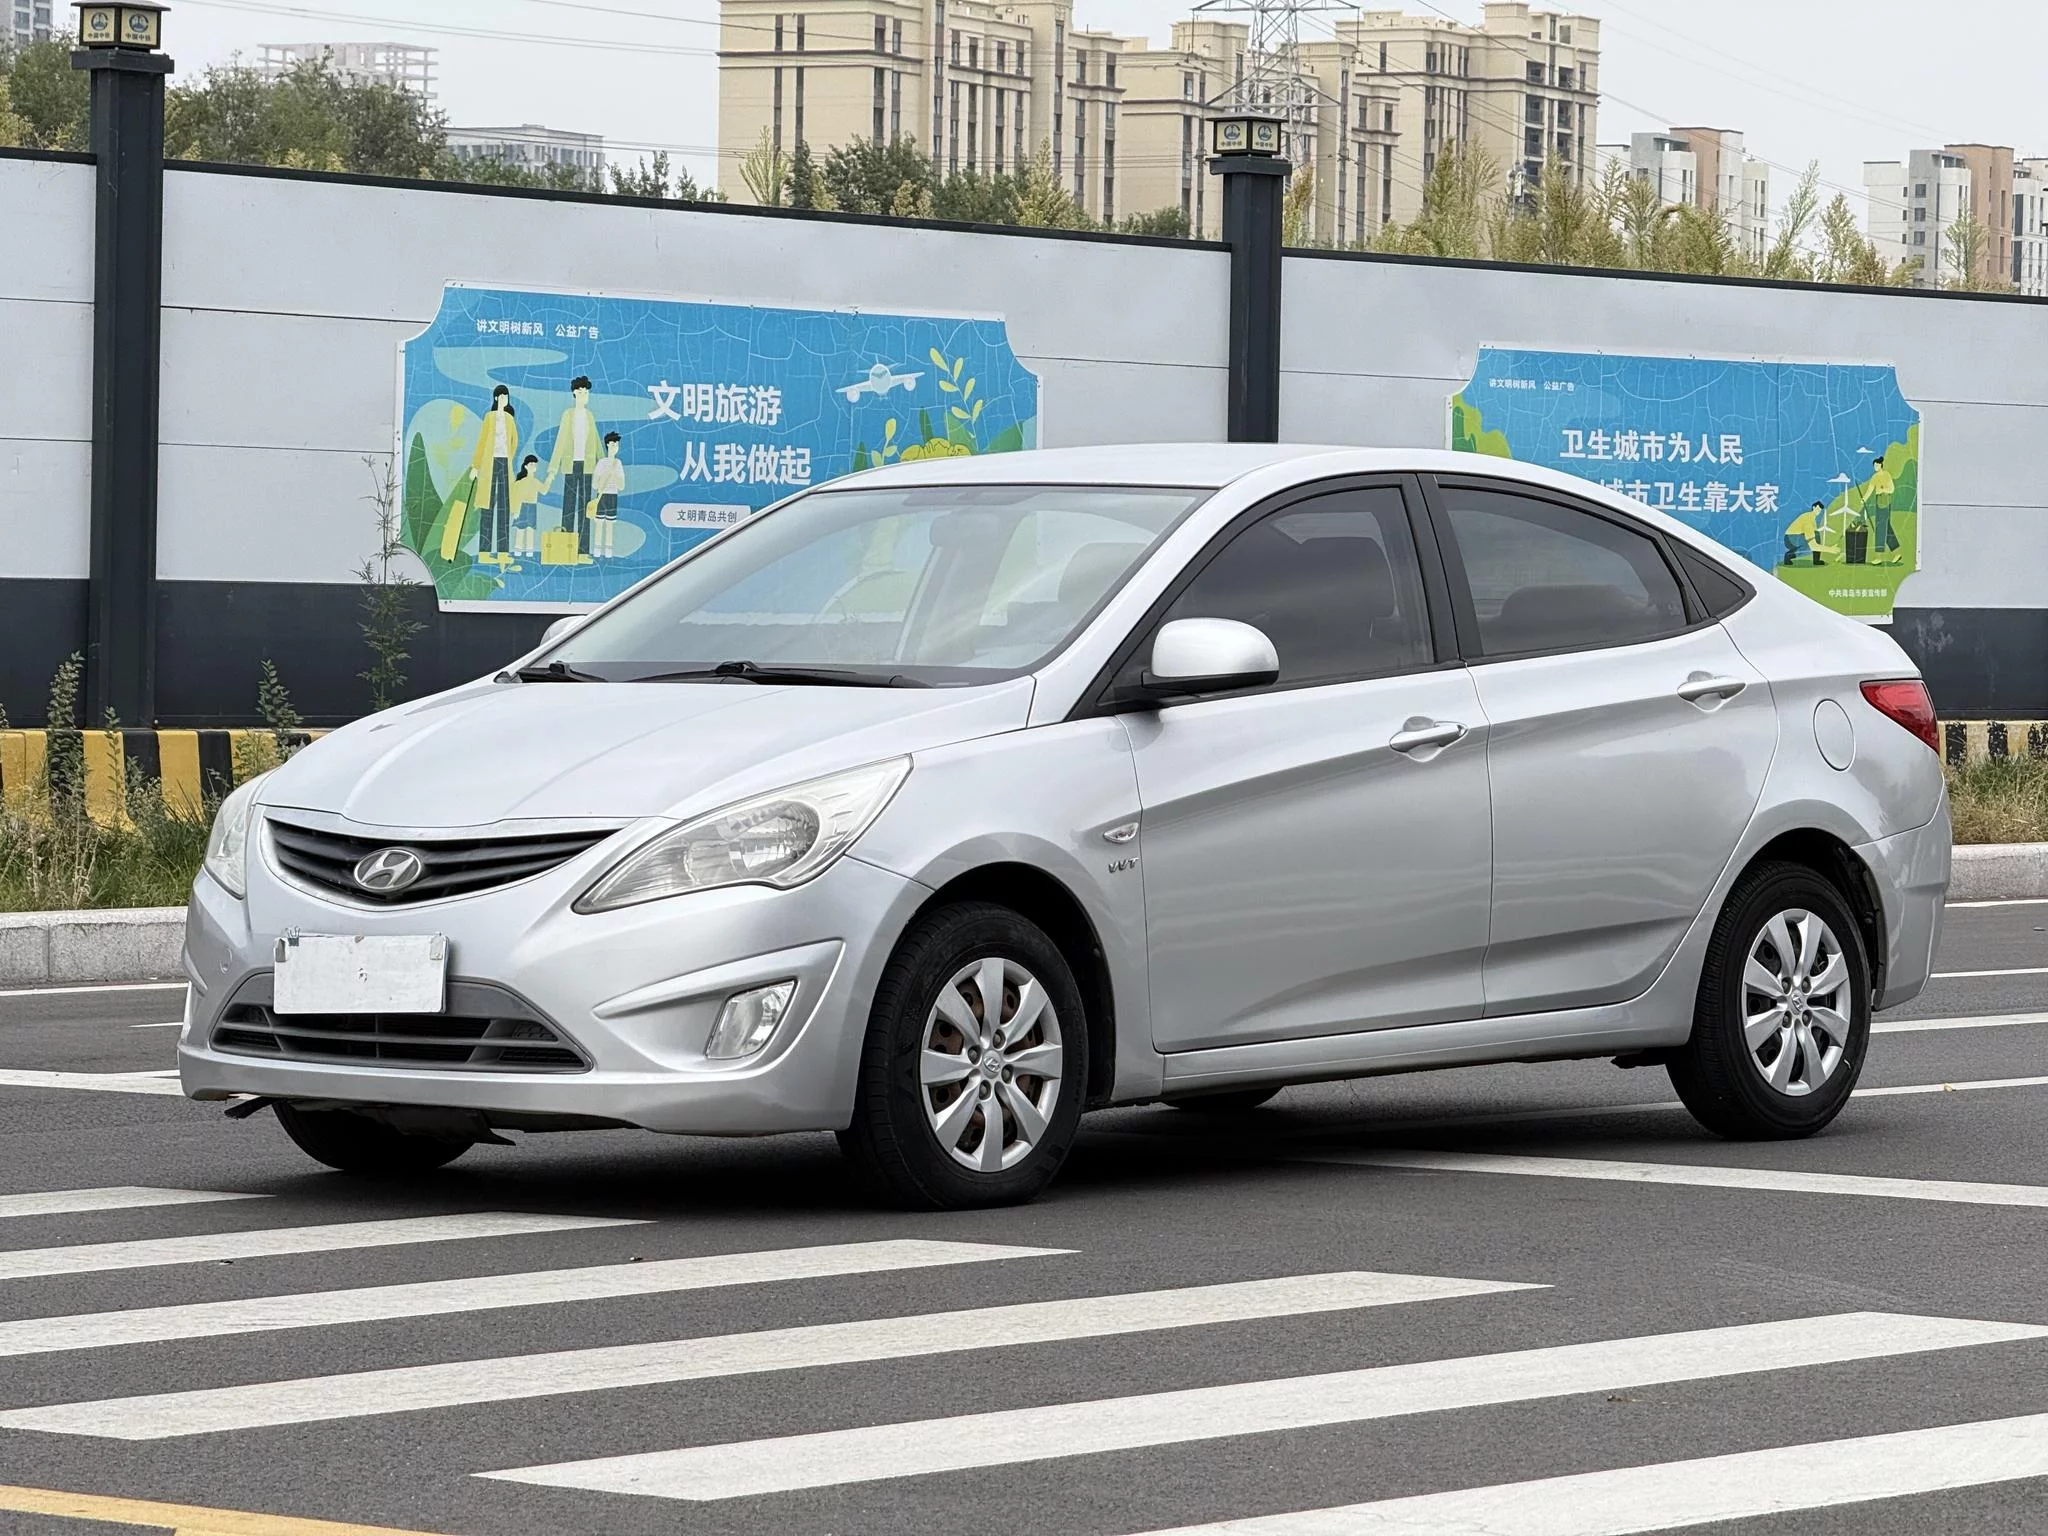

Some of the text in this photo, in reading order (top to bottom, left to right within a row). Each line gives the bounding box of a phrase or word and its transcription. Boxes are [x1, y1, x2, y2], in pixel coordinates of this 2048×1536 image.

[476, 319, 600, 339] 讲文明树新风 公益广告
[647, 380, 782, 426] 文明旅游
[679, 441, 812, 486] 从我做起
[1559, 428, 1743, 465] 卫生城市为人民
[676, 509, 738, 523] 文明青岛共创
